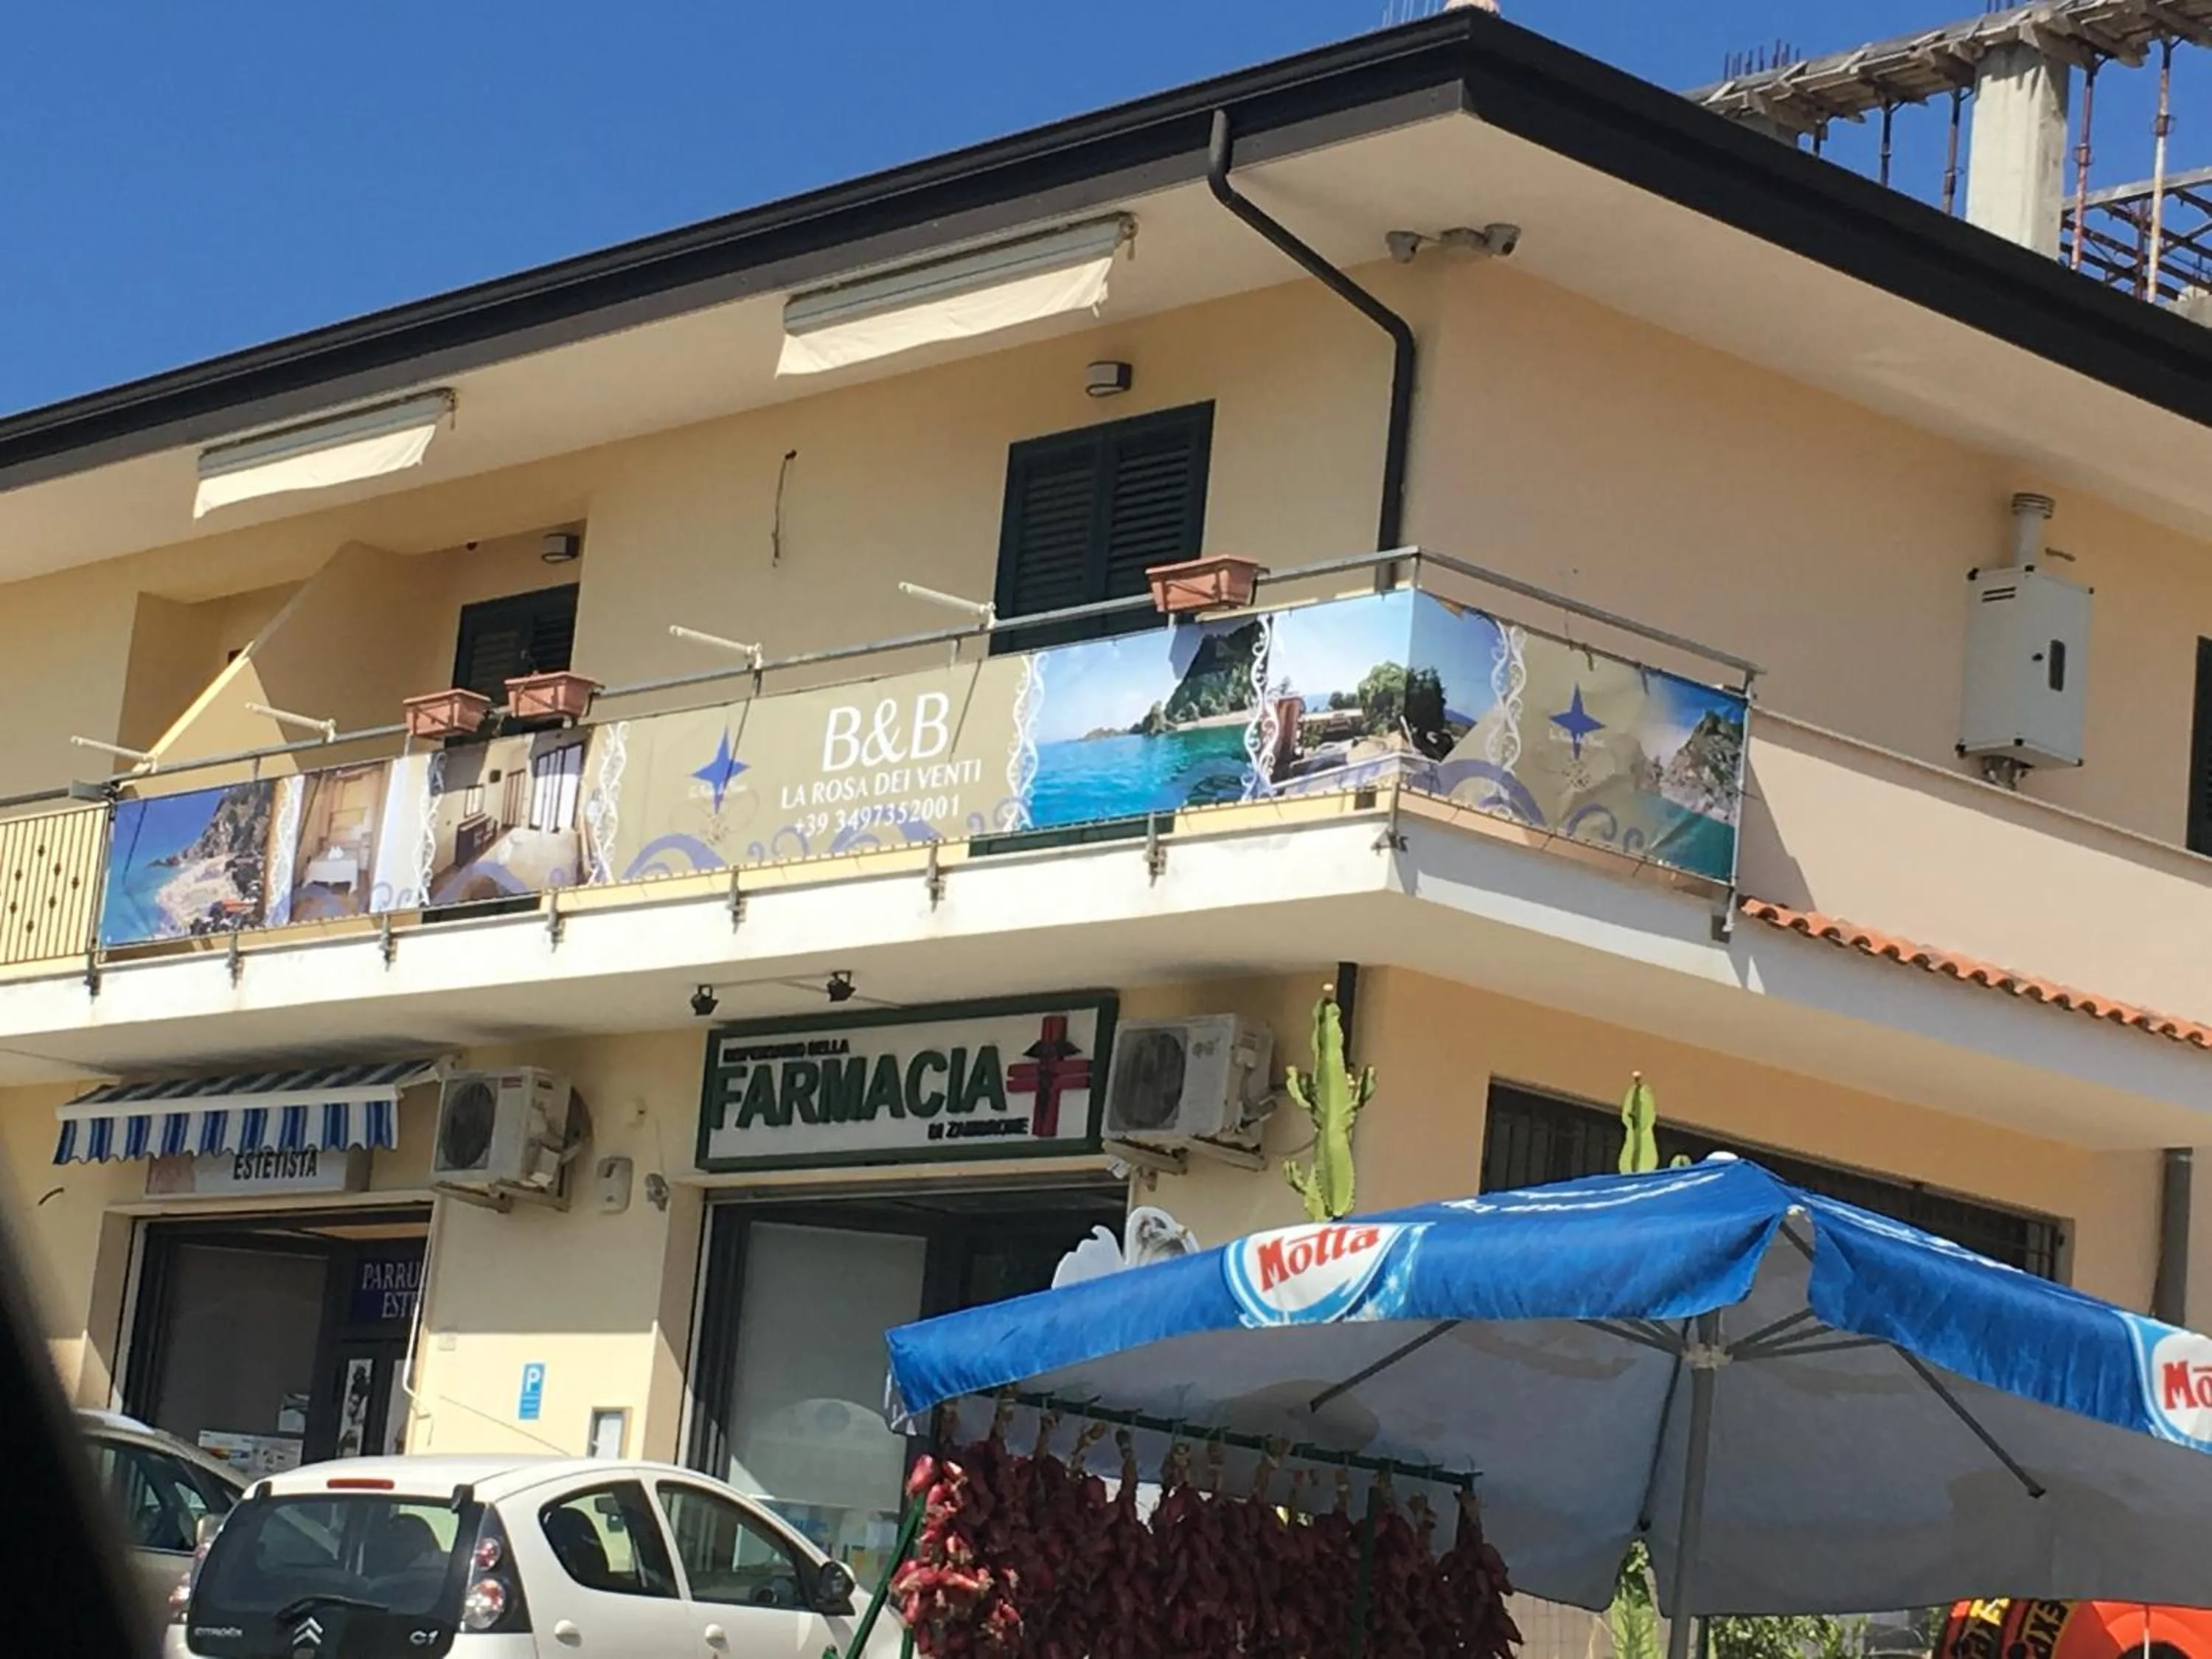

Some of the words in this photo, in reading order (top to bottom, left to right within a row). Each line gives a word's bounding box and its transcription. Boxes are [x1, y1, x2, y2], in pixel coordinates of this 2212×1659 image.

[821, 692, 950, 773] B&B
[780, 785, 807, 810] LA
[811, 774, 869, 805] ROSA
[874, 770, 911, 796] DEI
[917, 759, 983, 788] VENTI
[793, 810, 829, 838] +39
[833, 793, 960, 834] 3497352001
[709, 1045, 1007, 1130] FARMACIA
[233, 1147, 318, 1180] ESTETISTA
[1257, 1225, 1380, 1292] Motta
[525, 1367, 542, 1393] P
[409, 1630, 439, 1646] C1
